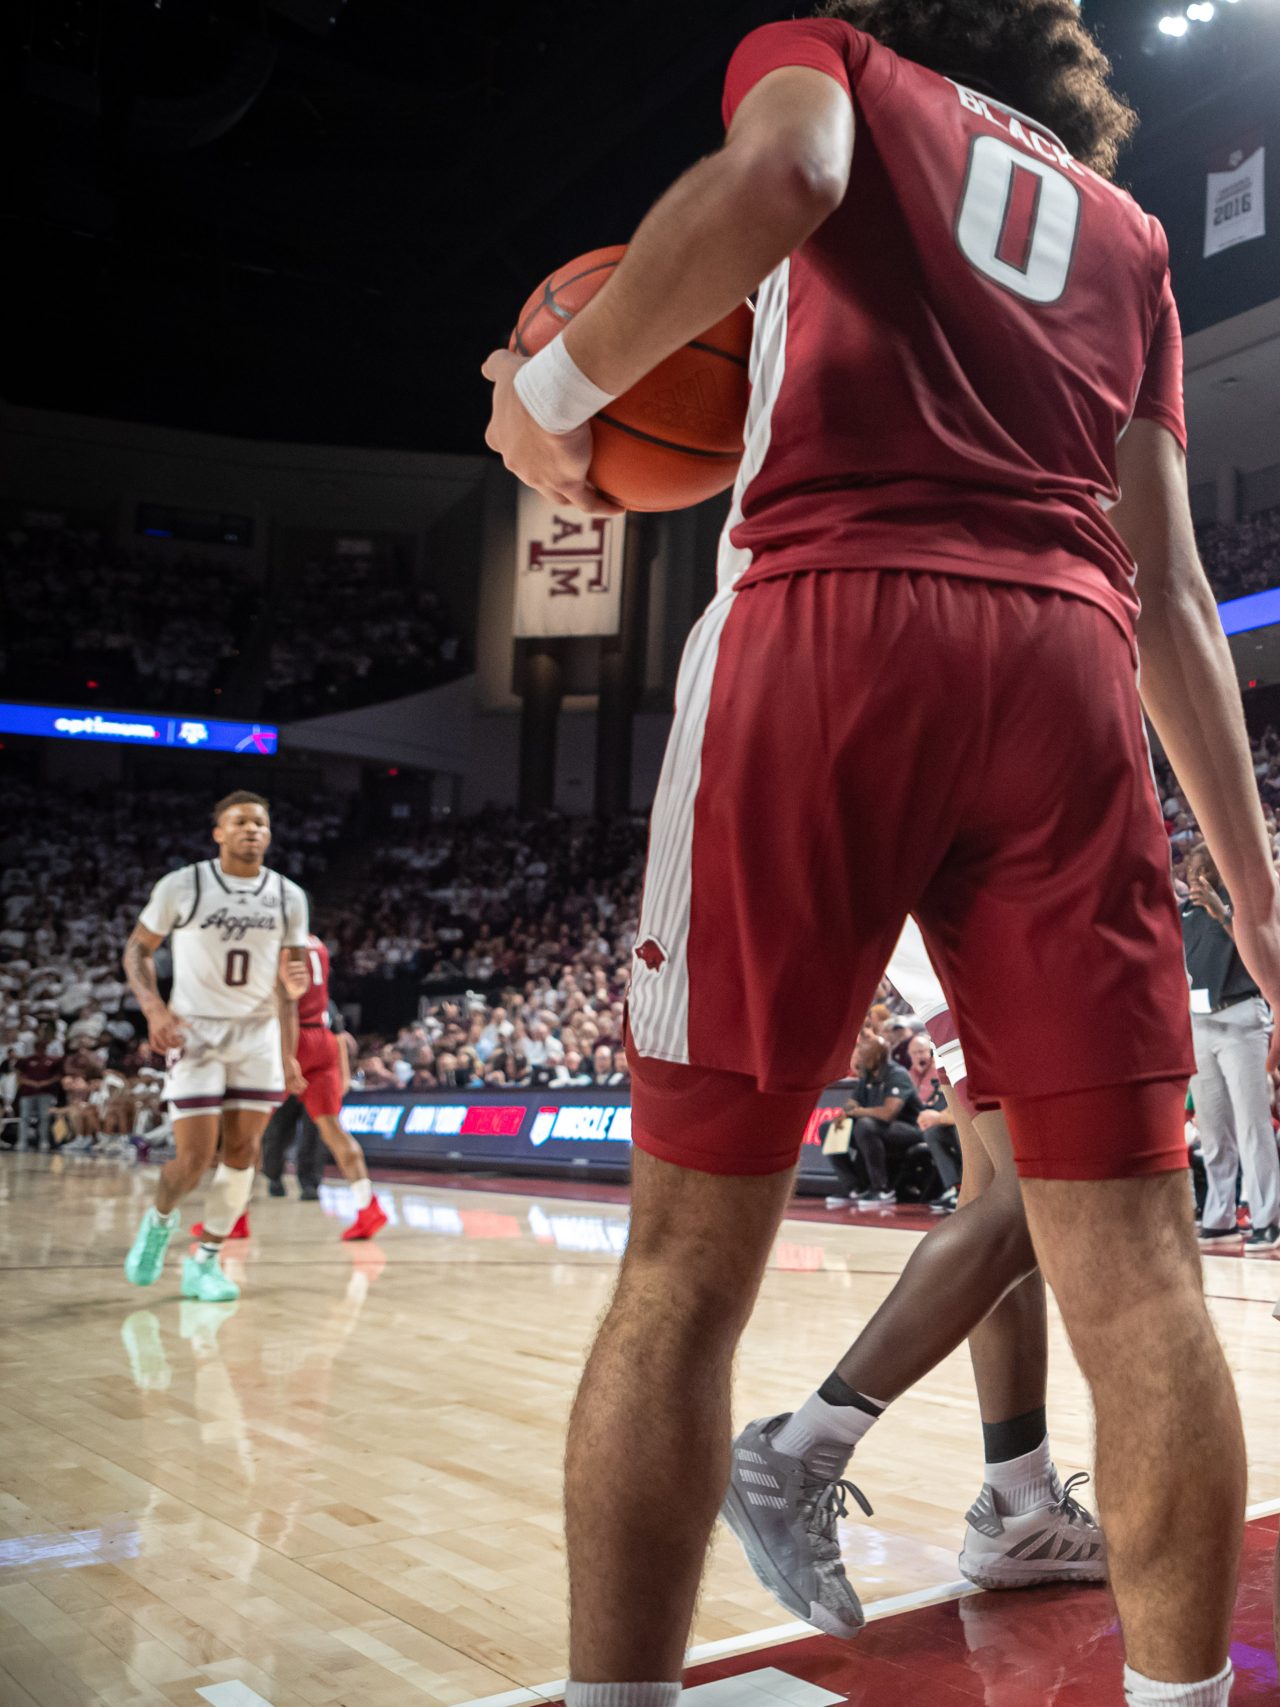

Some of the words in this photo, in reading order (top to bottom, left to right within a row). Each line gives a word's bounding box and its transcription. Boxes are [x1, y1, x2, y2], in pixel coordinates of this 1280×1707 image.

[958, 84, 1085, 177] BLACK
[954, 132, 1082, 306] 0
[1212, 191, 1252, 227] 2016
[224, 948, 250, 987] 0
